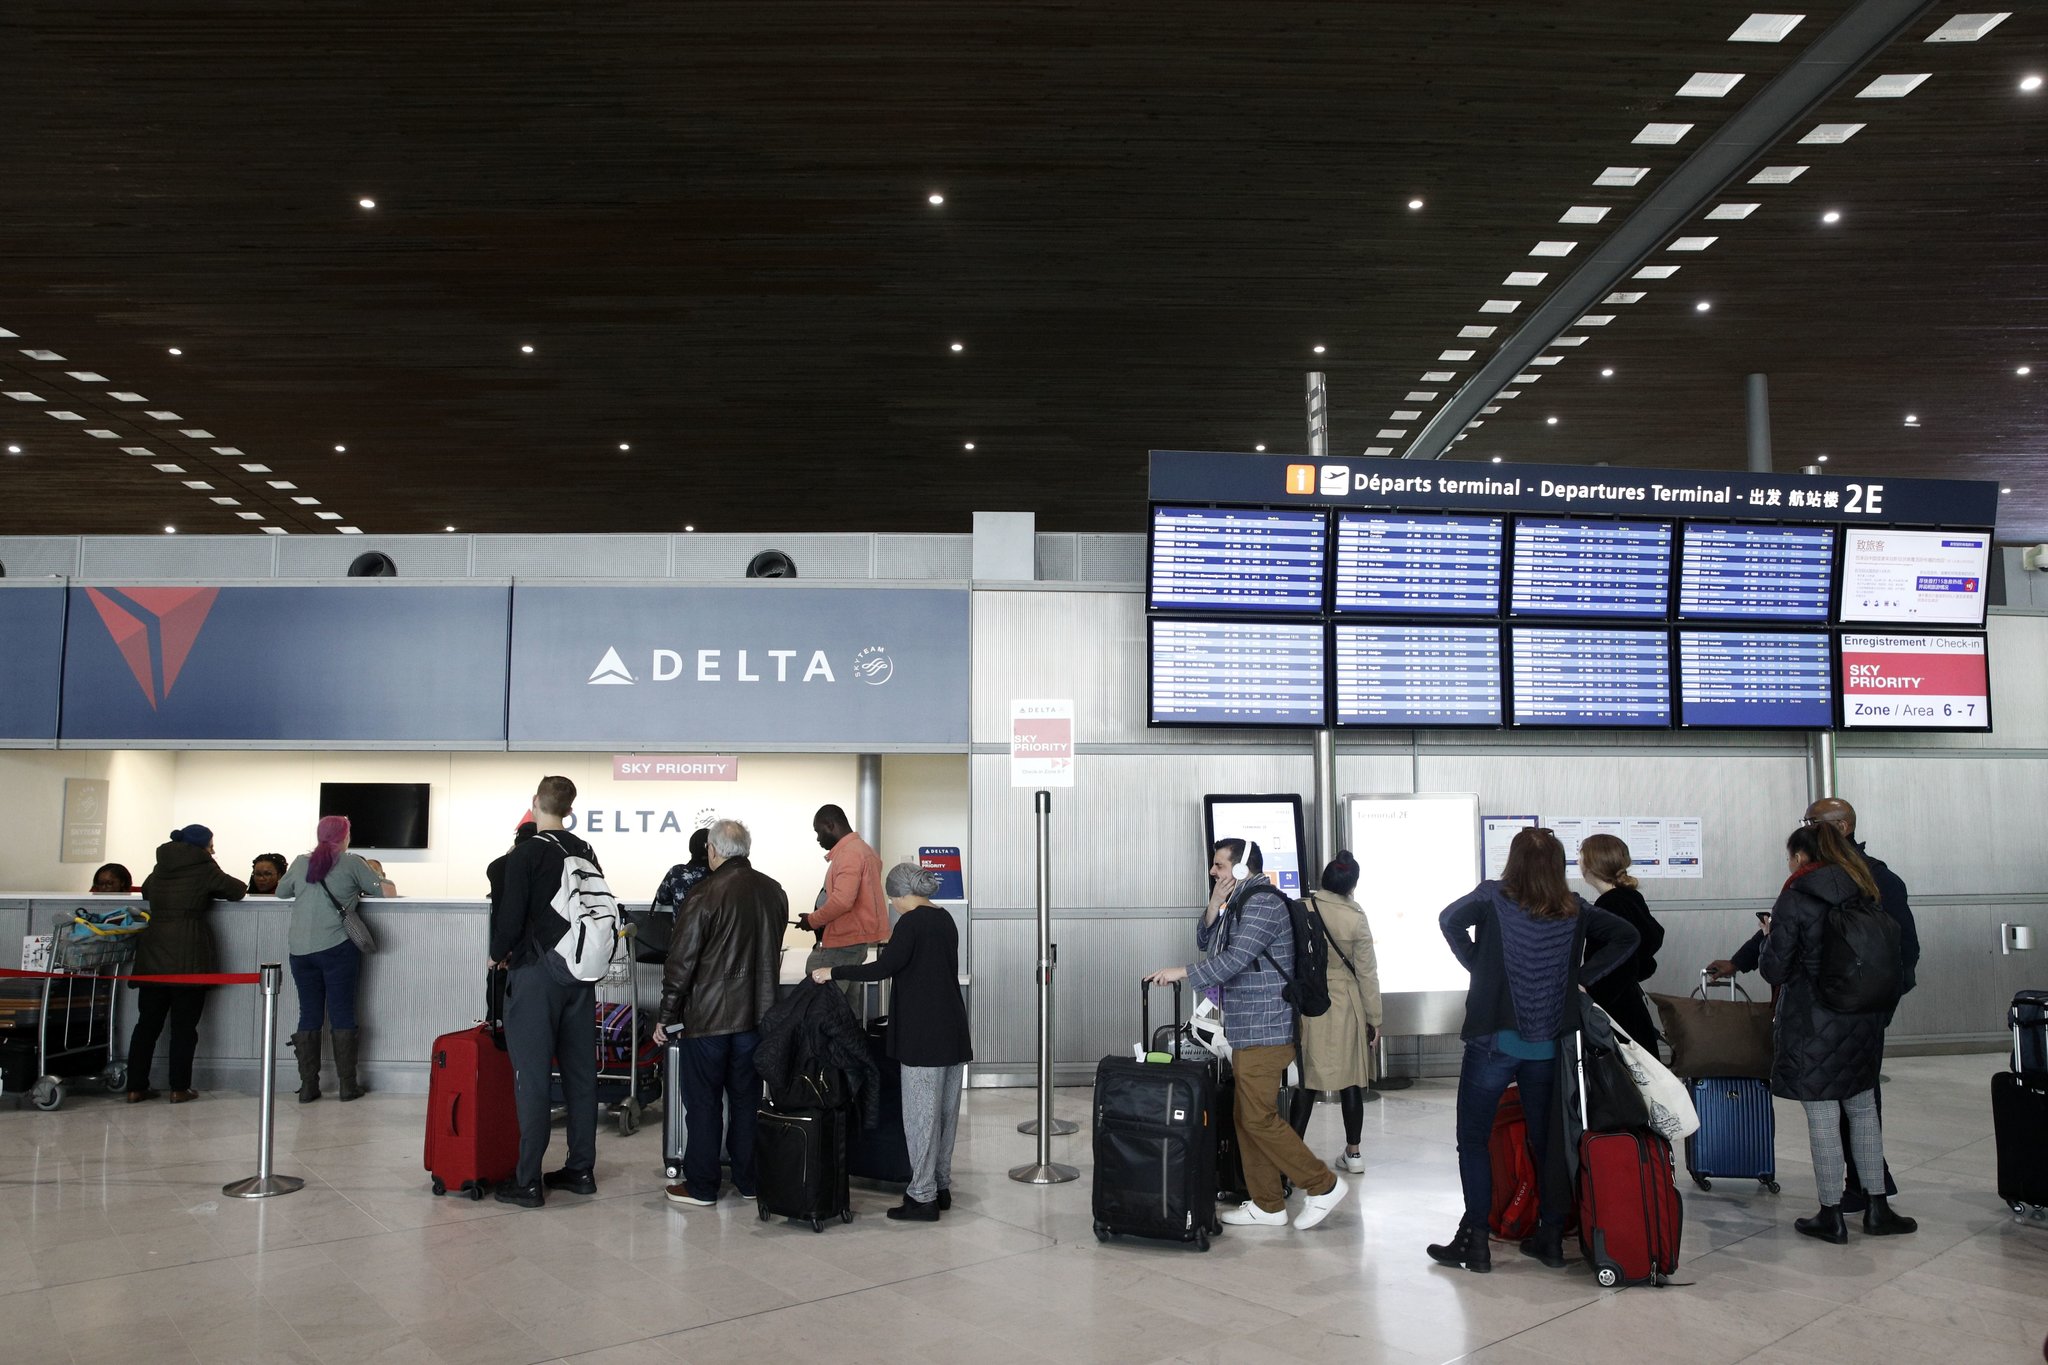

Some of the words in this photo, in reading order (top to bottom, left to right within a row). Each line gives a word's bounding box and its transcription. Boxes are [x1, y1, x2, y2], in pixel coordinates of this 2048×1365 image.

[1354, 473, 1431, 497] Départs
[1438, 477, 1520, 496] terminal
[1540, 480, 1646, 502] Departures
[1651, 484, 1730, 503] Terminal
[1749, 488, 1782, 506] 出发
[1788, 490, 1839, 509] 航站楼
[1844, 484, 1884, 514] 2E
[1844, 636, 1926, 648] Enregistrement
[1936, 638, 1980, 648] Check-in
[652, 649, 836, 682] DELTA
[854, 646, 885, 677] SKYTEAM
[1849, 665, 1880, 676] SKY
[1850, 677, 1921, 688] PRIORITY
[1854, 703, 1890, 715] Zone
[1903, 704, 1934, 716] Area
[1943, 704, 1952, 716] 6
[1966, 704, 1975, 716] 7
[1014, 735, 1037, 743] SKY
[1014, 743, 1067, 752] PRIORITY
[621, 763, 651, 774] SKY
[656, 763, 726, 774] PRIORITY
